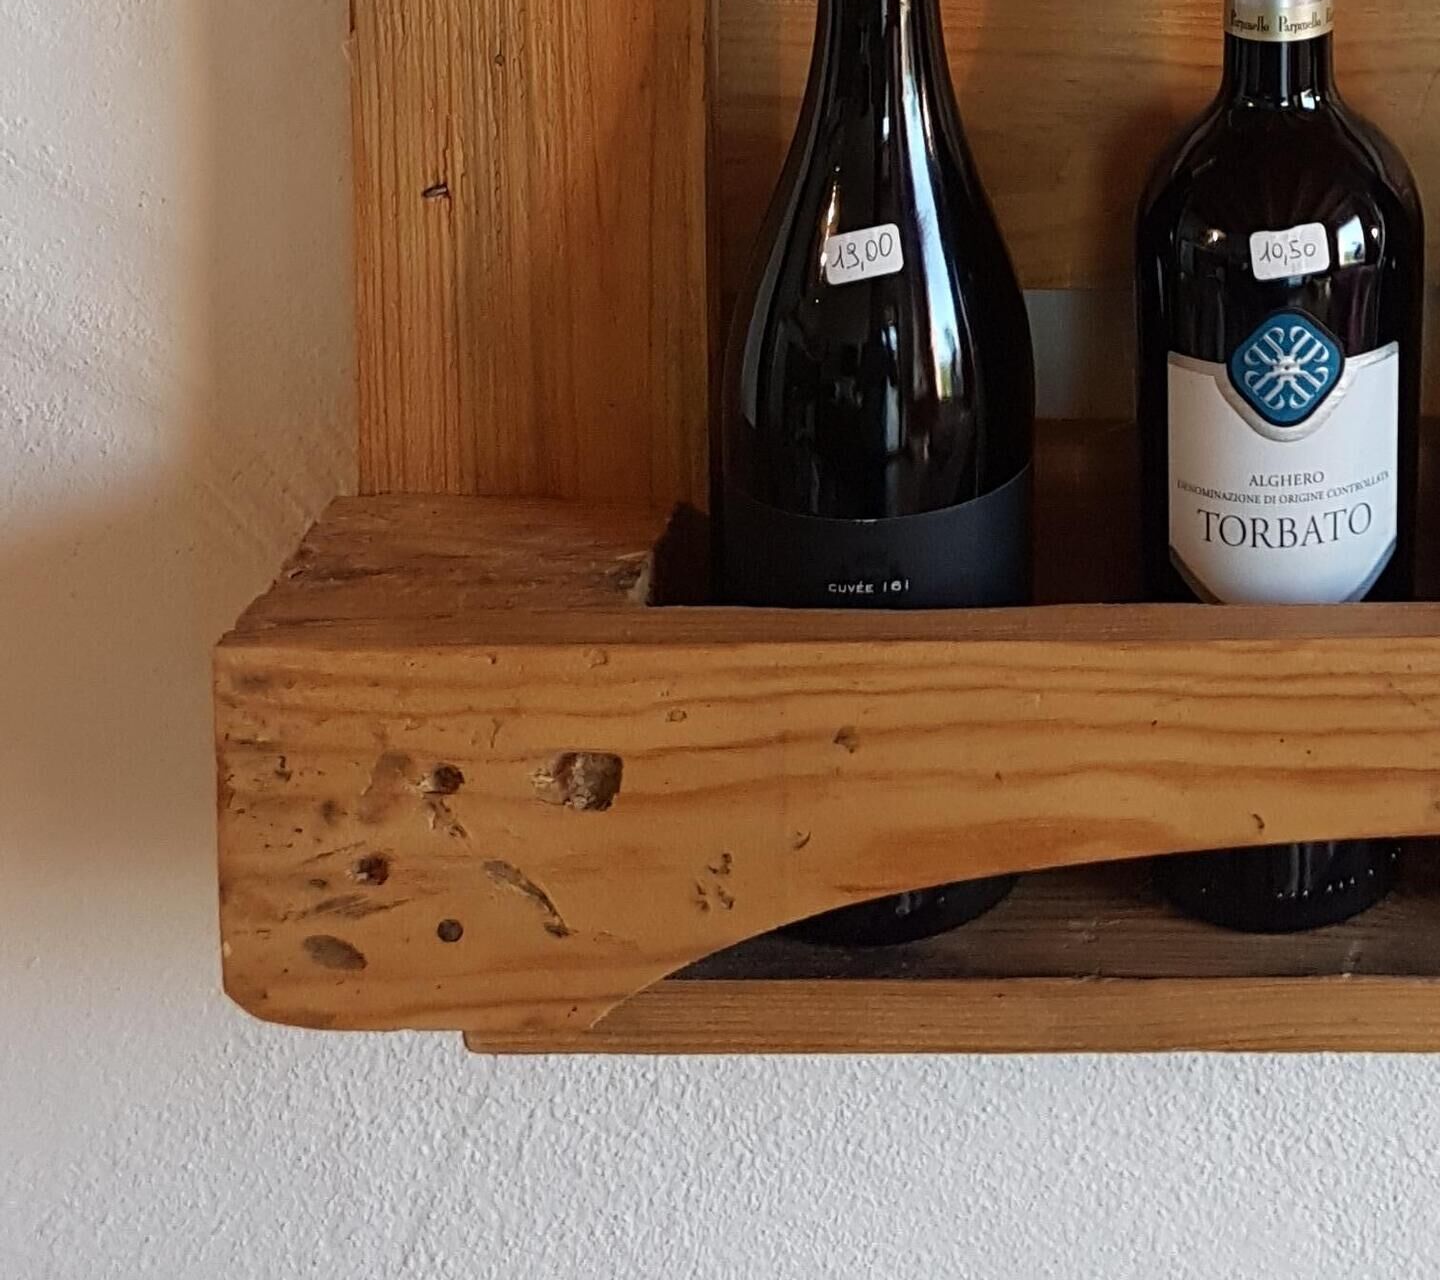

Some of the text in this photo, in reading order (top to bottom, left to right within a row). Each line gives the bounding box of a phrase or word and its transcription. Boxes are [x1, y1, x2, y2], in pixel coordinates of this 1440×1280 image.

[1259, 239, 1317, 266] 10,50
[1248, 470, 1325, 488] ALGHERO
[1263, 494, 1277, 505] DI
[1278, 490, 1326, 504] ORIGINE
[1196, 502, 1372, 549] TORBATO
[828, 580, 875, 593] CUVÉE
